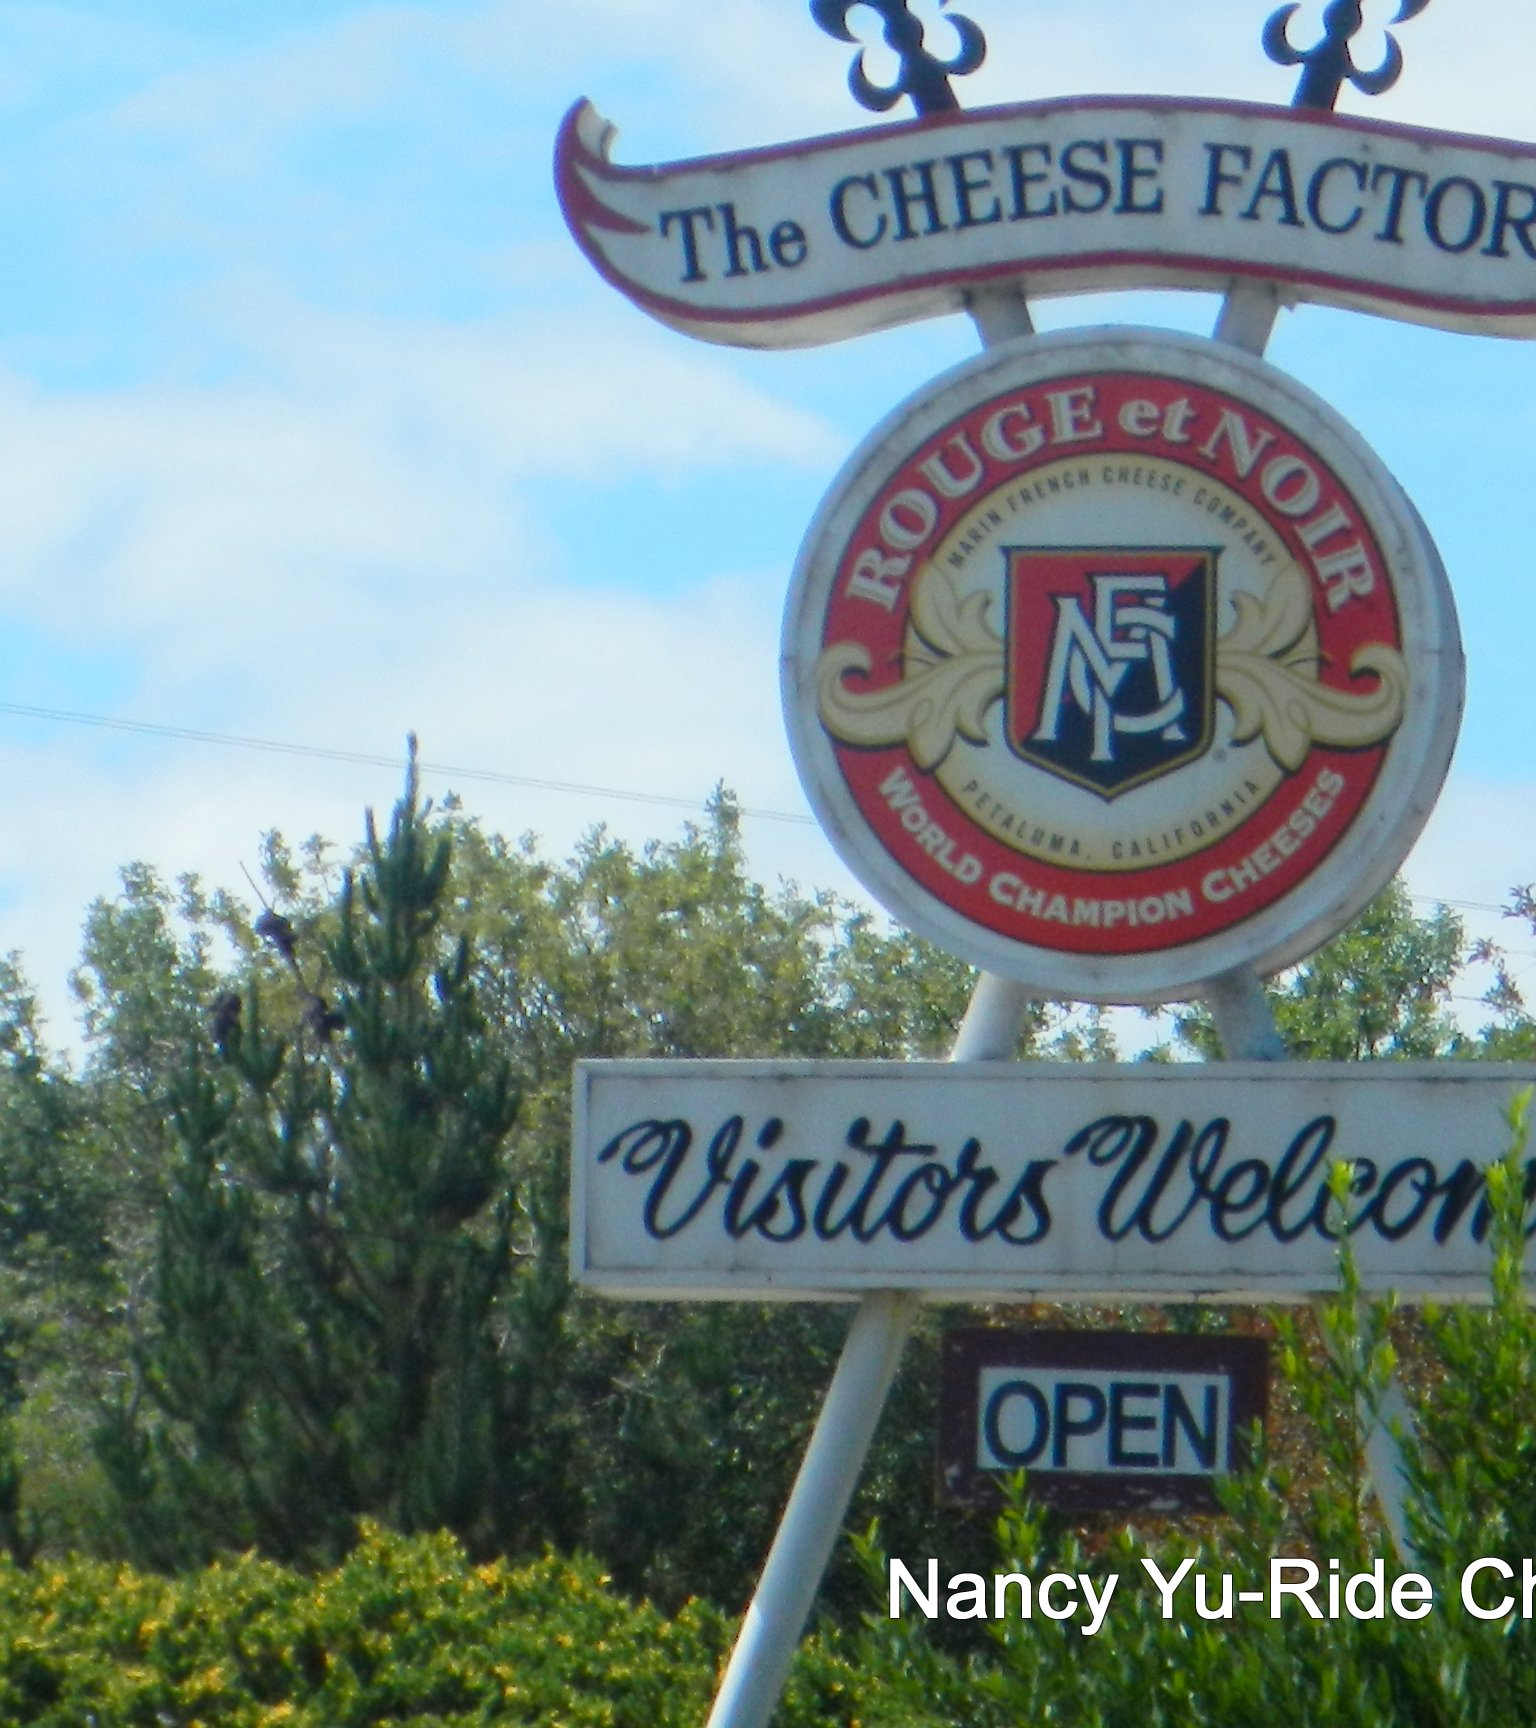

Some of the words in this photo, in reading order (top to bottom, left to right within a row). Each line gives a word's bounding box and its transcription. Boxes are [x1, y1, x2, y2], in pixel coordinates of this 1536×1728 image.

[657, 201, 809, 283] The
[828, 138, 1166, 251] CHEESE
[842, 384, 1106, 614] ROUGE
[1117, 393, 1196, 445] et
[1199, 405, 1380, 616] NOIR
[947, 508, 1004, 569] MARIN
[1008, 468, 1091, 512] FRENCH
[1102, 466, 1187, 497] CHEESE
[1193, 487, 1277, 566] COMPANY
[876, 767, 983, 888] WORLD
[988, 872, 1194, 930] CHAMPION
[1201, 767, 1347, 904] CHEESES
[1111, 778, 1261, 860] CALIFORNIA
[598, 1113, 1062, 1246] Visitors
[982, 1379, 1220, 1470] OPEN
